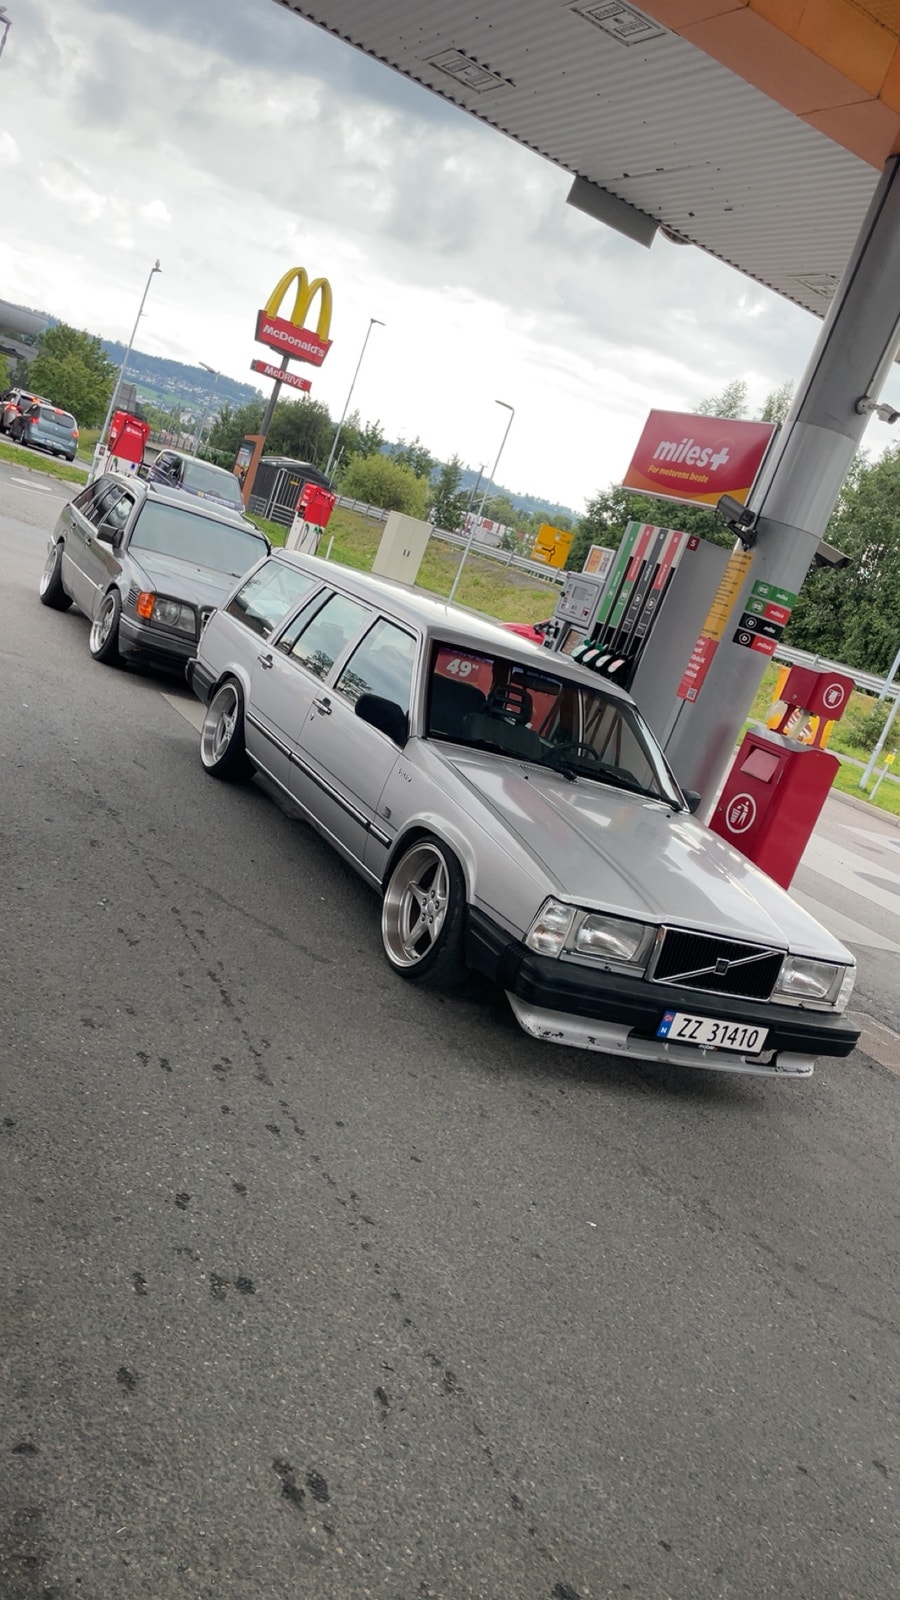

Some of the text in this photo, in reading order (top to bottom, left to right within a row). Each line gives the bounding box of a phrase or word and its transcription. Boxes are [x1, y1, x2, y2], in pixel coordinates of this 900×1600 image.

[262, 324, 326, 358] McDonald's
[263, 365, 305, 388] McDRIVE
[647, 464, 710, 484] For motorens beste
[446, 658, 472, 678] 49
[677, 1018, 759, 1048] ZZ 31410
